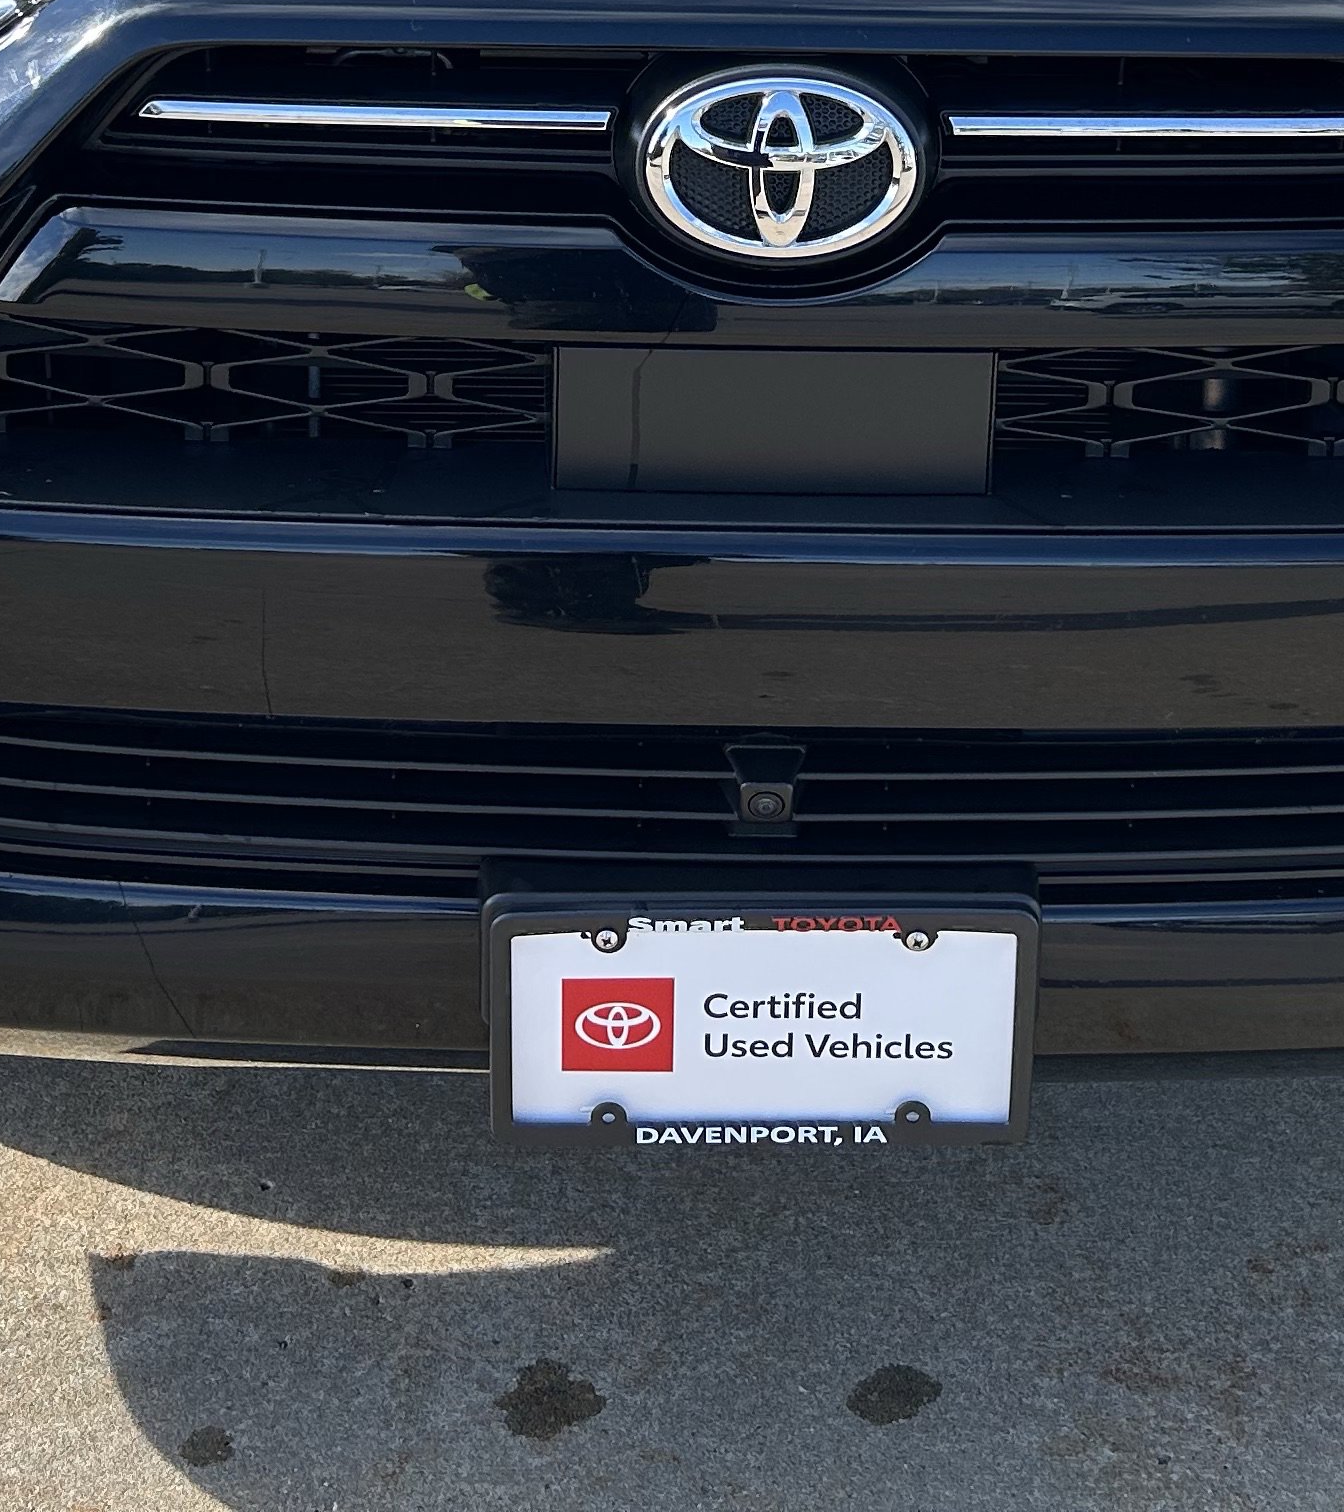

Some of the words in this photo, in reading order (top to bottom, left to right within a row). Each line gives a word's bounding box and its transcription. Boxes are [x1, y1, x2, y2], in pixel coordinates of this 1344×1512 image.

[627, 915, 745, 934] Smart
[771, 915, 903, 933] TOYOTA
[703, 992, 862, 1020] Certified
[703, 1032, 794, 1059] Used
[805, 1033, 954, 1060] Vehicles
[636, 1126, 843, 1146] DAVENPORT,
[853, 1125, 888, 1144] IA
